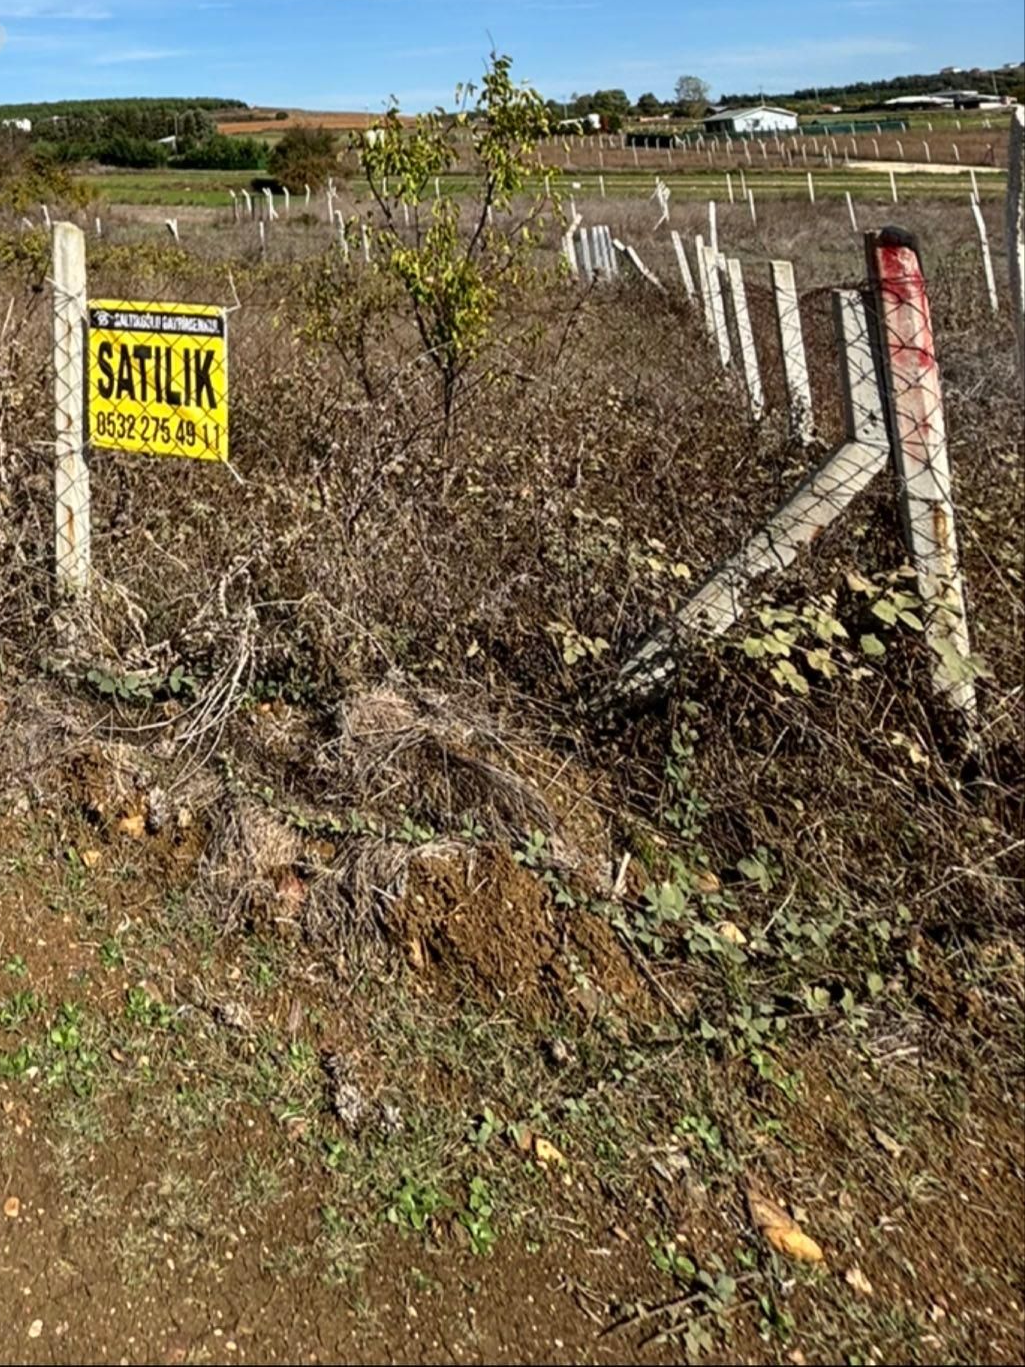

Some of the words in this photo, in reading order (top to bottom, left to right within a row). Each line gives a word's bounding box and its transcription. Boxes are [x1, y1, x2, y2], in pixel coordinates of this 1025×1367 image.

[97, 340, 217, 410] SATILIK
[97, 411, 136, 440] 0532
[140, 415, 171, 444] 275
[176, 419, 196, 447] 49
